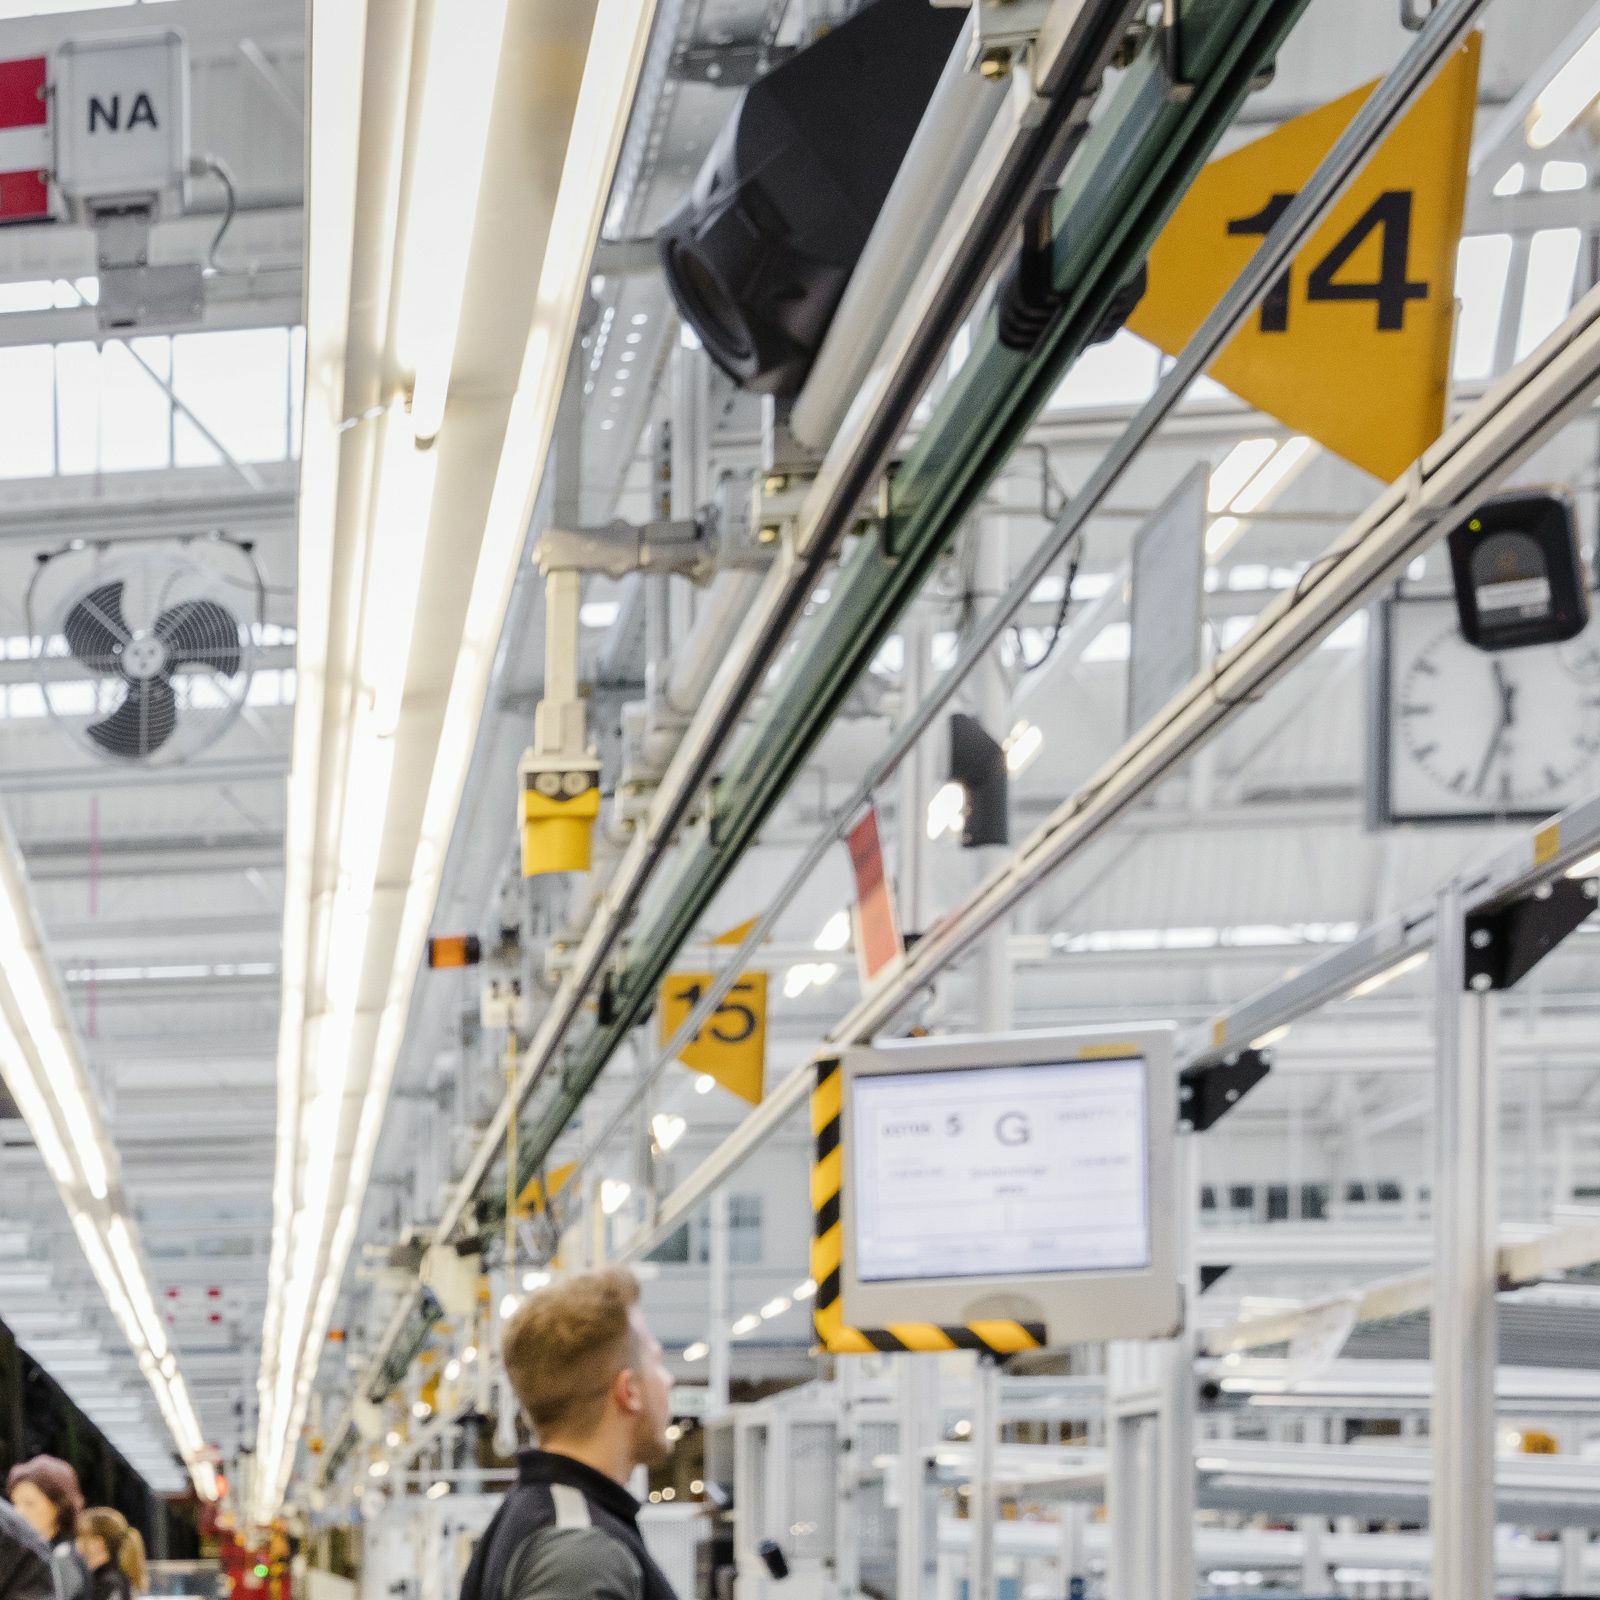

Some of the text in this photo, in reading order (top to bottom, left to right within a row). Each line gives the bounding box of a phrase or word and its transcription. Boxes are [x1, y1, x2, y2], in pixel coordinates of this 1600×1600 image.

[88, 92, 159, 135] NA
[1225, 189, 1428, 333] 14
[673, 983, 756, 1043] 15
[995, 1110, 1031, 1147] G
